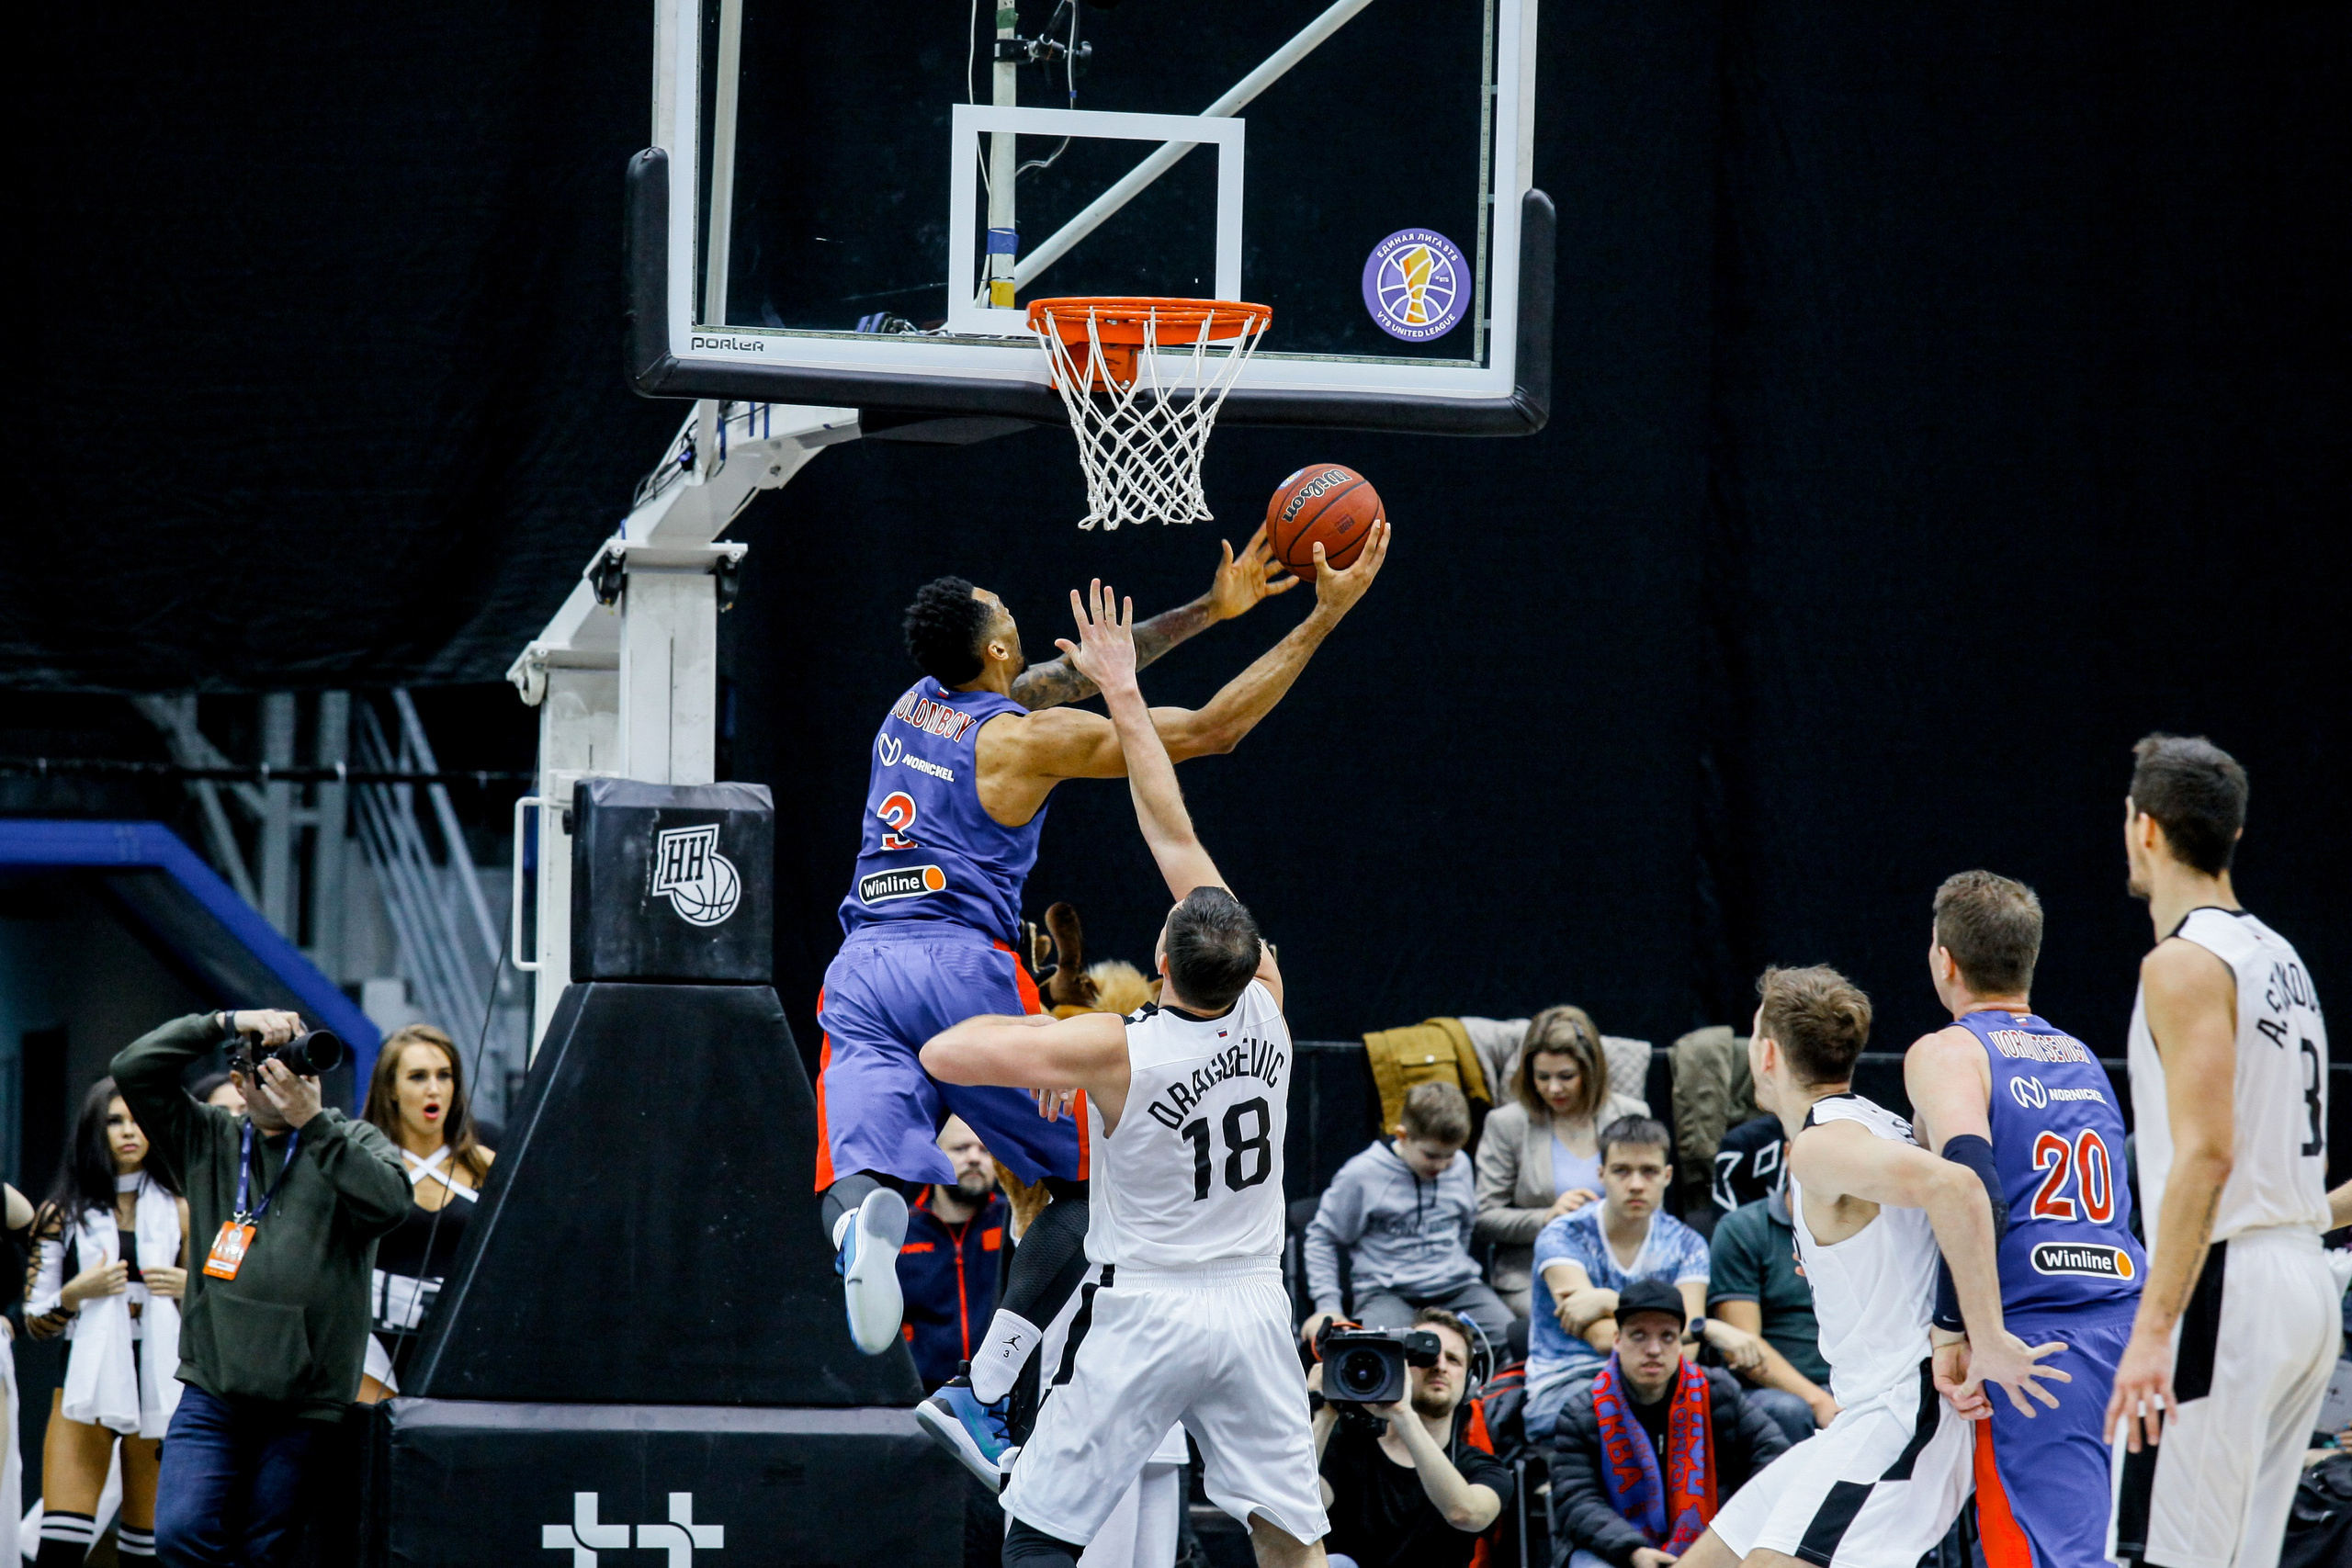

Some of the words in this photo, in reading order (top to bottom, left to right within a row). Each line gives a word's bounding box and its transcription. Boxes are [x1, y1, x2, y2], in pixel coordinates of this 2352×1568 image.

[1376, 233, 1415, 258] ЕДИНАЯ
[1417, 233, 1442, 248] ЛИГА
[1442, 244, 1459, 262] ВТБ
[1376, 310, 1391, 327] VTB
[1391, 324, 1424, 338] UNITED
[1424, 313, 1456, 336] LEAGUE
[889, 690, 978, 743] OLOMBOY
[863, 873, 921, 898] Winline
[1181, 1096, 1272, 1202] 18
[2030, 1127, 2116, 1224] 20
[2041, 1249, 2113, 1271] Winline
[1002, 1349, 1010, 1359] 3
[1591, 1371, 1644, 1495] ОСКВА
